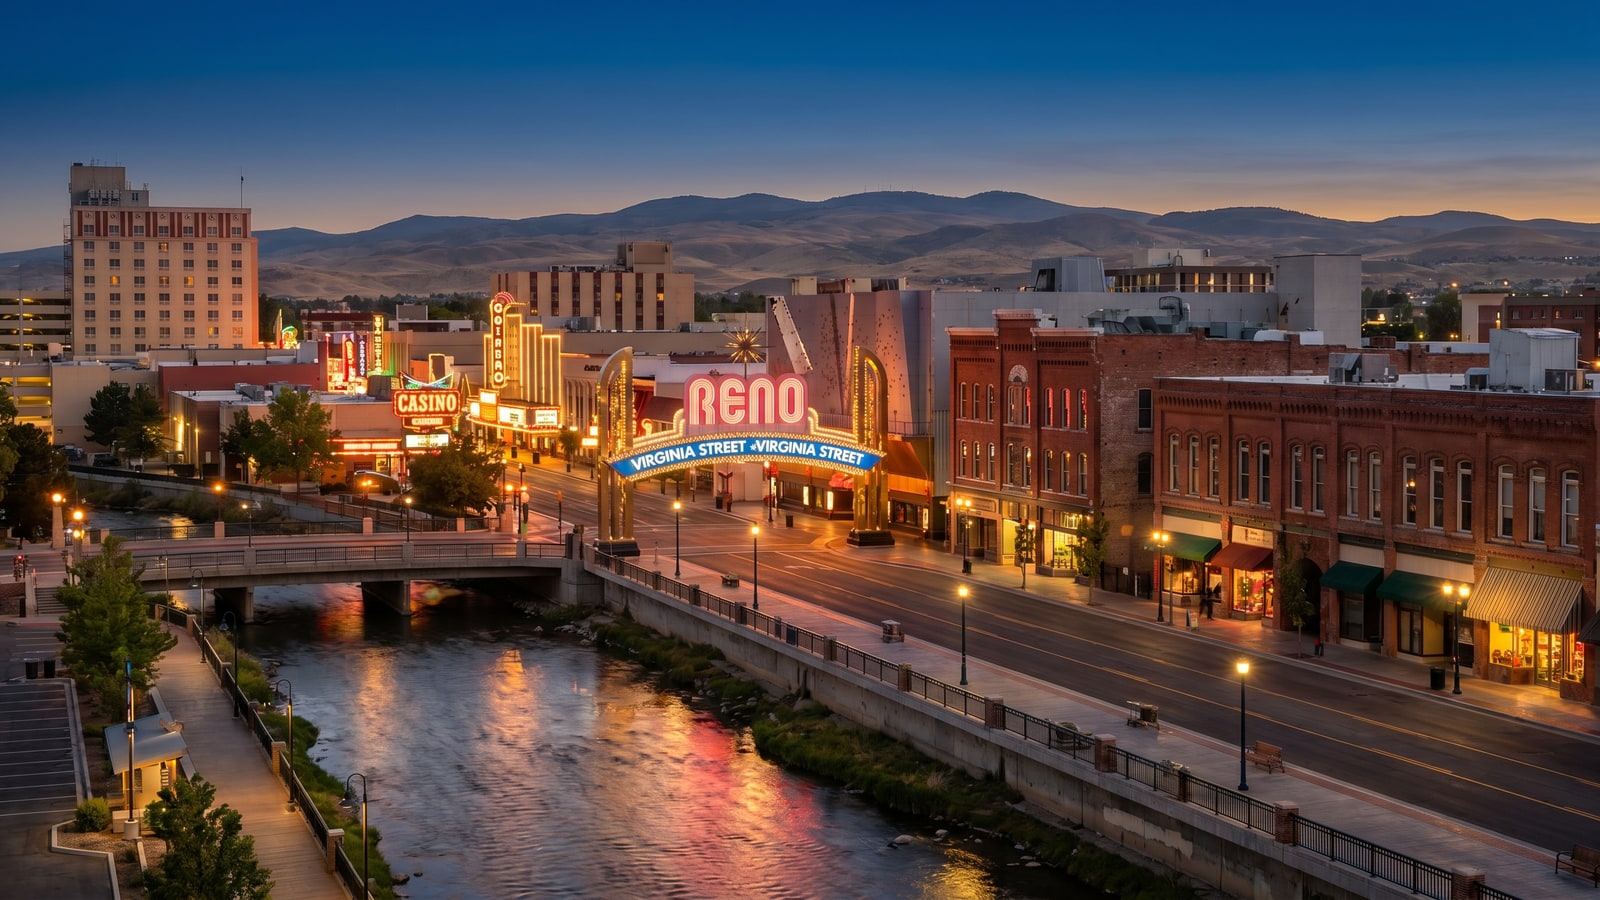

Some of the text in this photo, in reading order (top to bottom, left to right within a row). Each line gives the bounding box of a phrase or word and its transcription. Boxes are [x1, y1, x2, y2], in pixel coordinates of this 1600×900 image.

[398, 394, 457, 412] CASINO
[689, 378, 804, 424] RENO
[630, 440, 864, 470] VIRGINIA STREET VIRGINIA STREET
